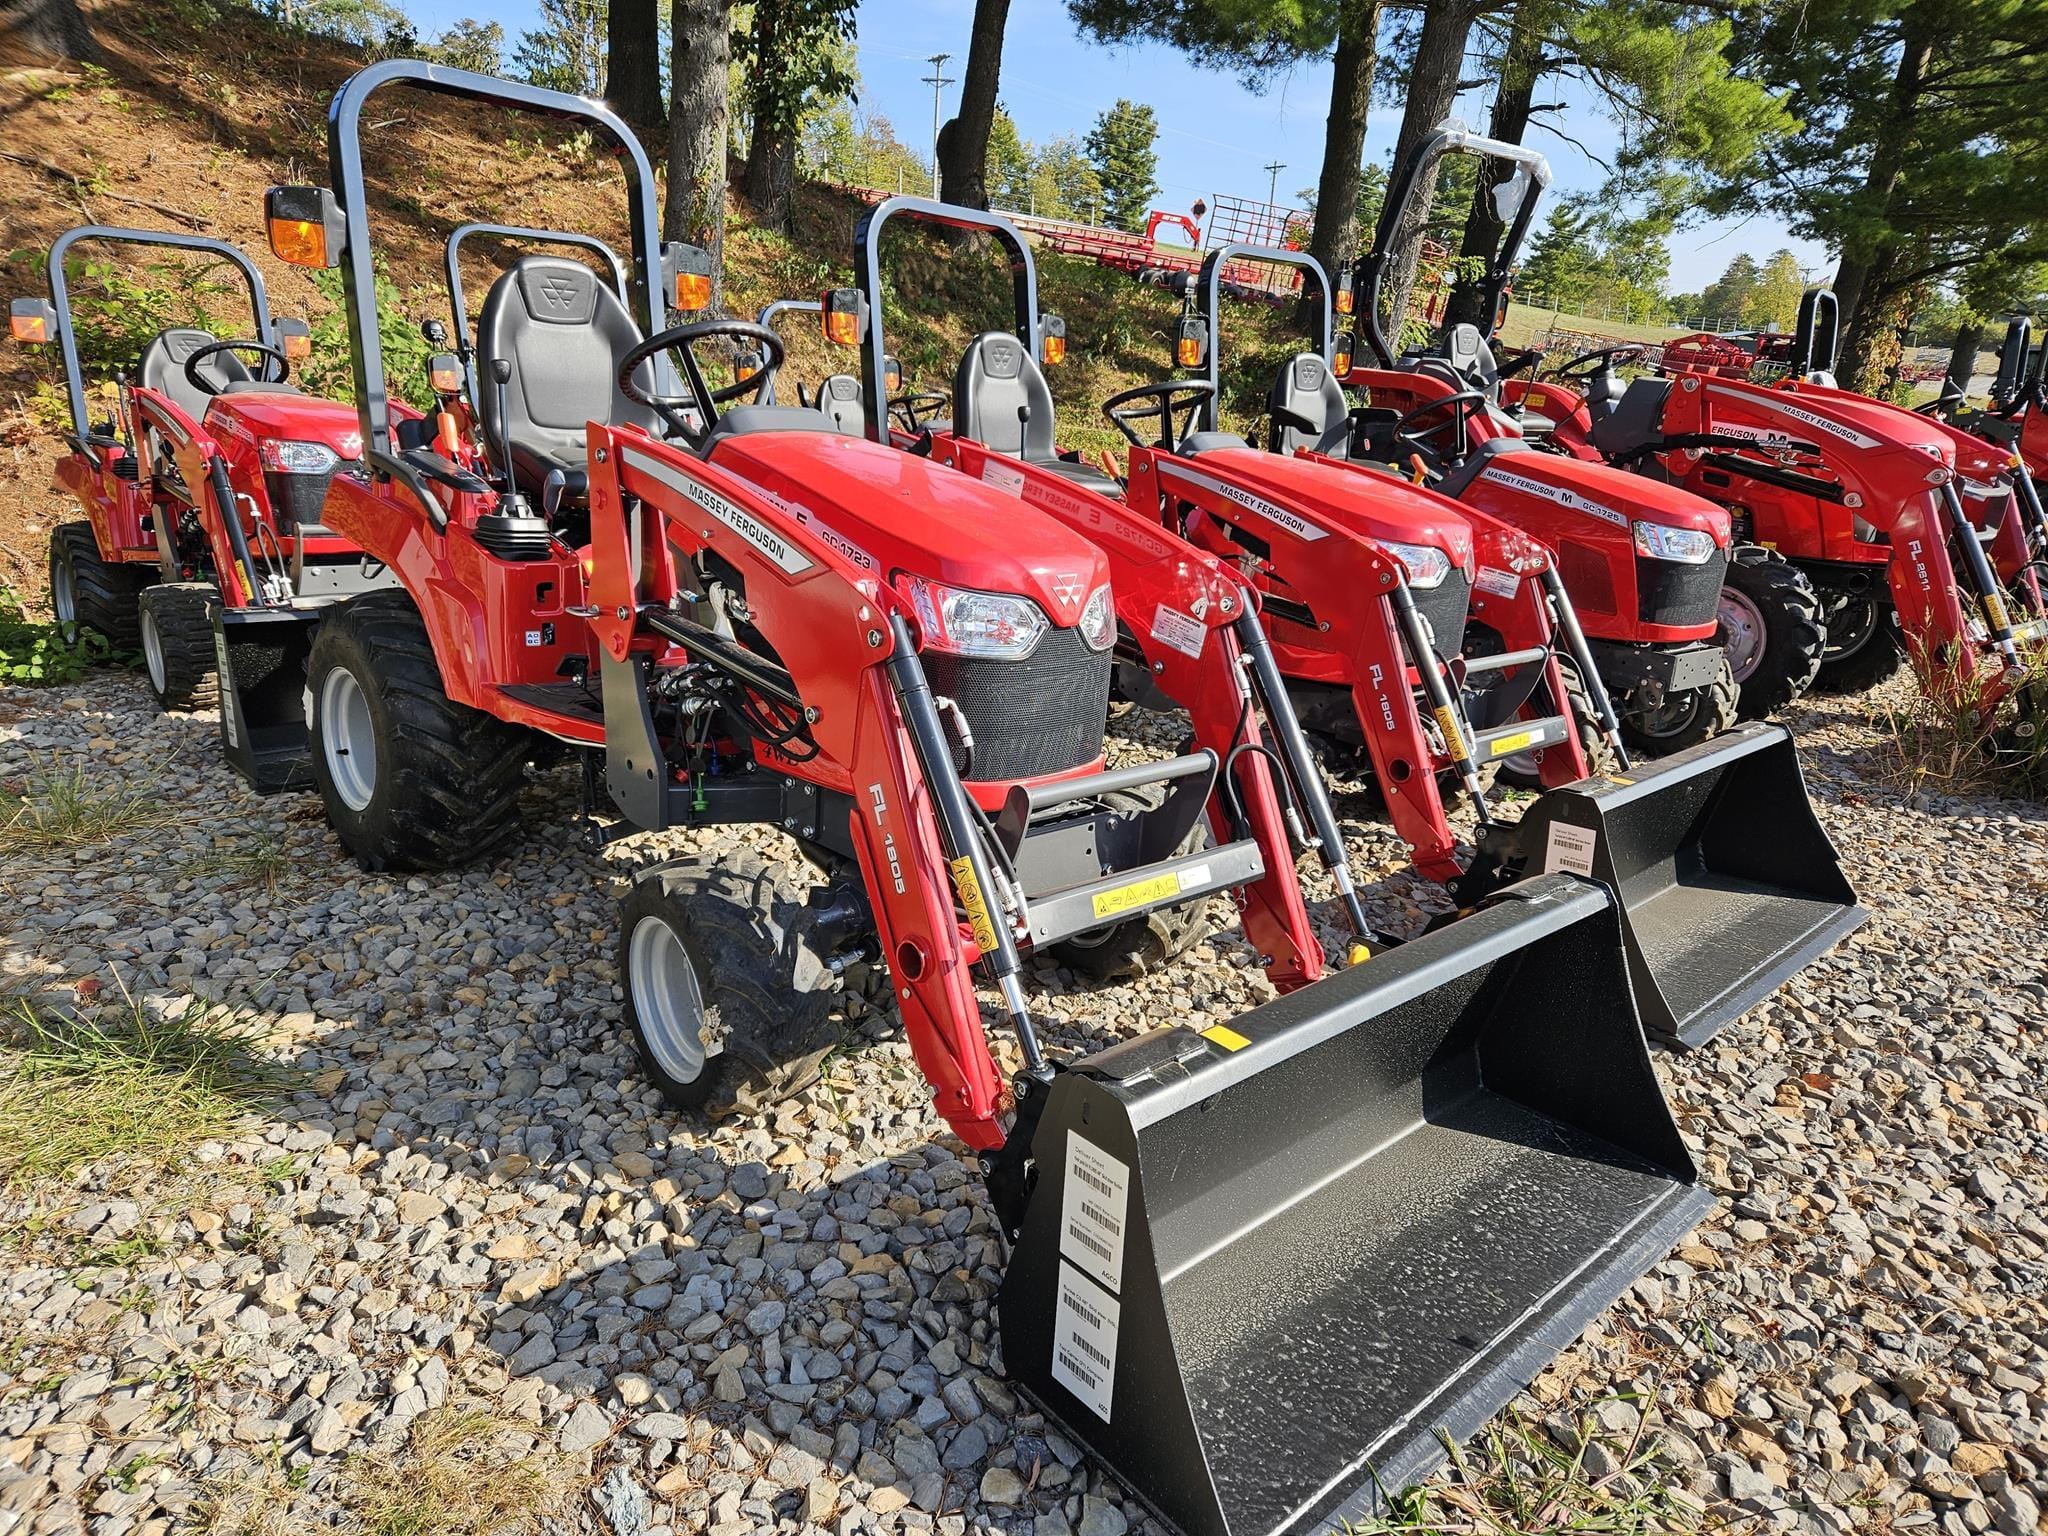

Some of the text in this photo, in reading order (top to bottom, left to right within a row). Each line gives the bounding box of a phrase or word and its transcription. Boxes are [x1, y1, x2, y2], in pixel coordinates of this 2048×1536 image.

[1712, 426, 1758, 440] ERGUSON
[1783, 406, 1858, 441] MASSEY FERGUSON
[1220, 485, 1305, 532] MASSEY FERGUSON
[1487, 470, 1516, 484] MASSEY
[1516, 480, 1555, 496] FERGUSON
[1561, 492, 1572, 504] M
[689, 484, 728, 517] MASSEY
[730, 512, 784, 560] FERGUSON
[1908, 540, 1931, 591] FL 2611
[1369, 664, 1395, 730] FL 1805
[868, 783, 905, 894] FL 1805
[1102, 1270, 1118, 1285] AGCO
